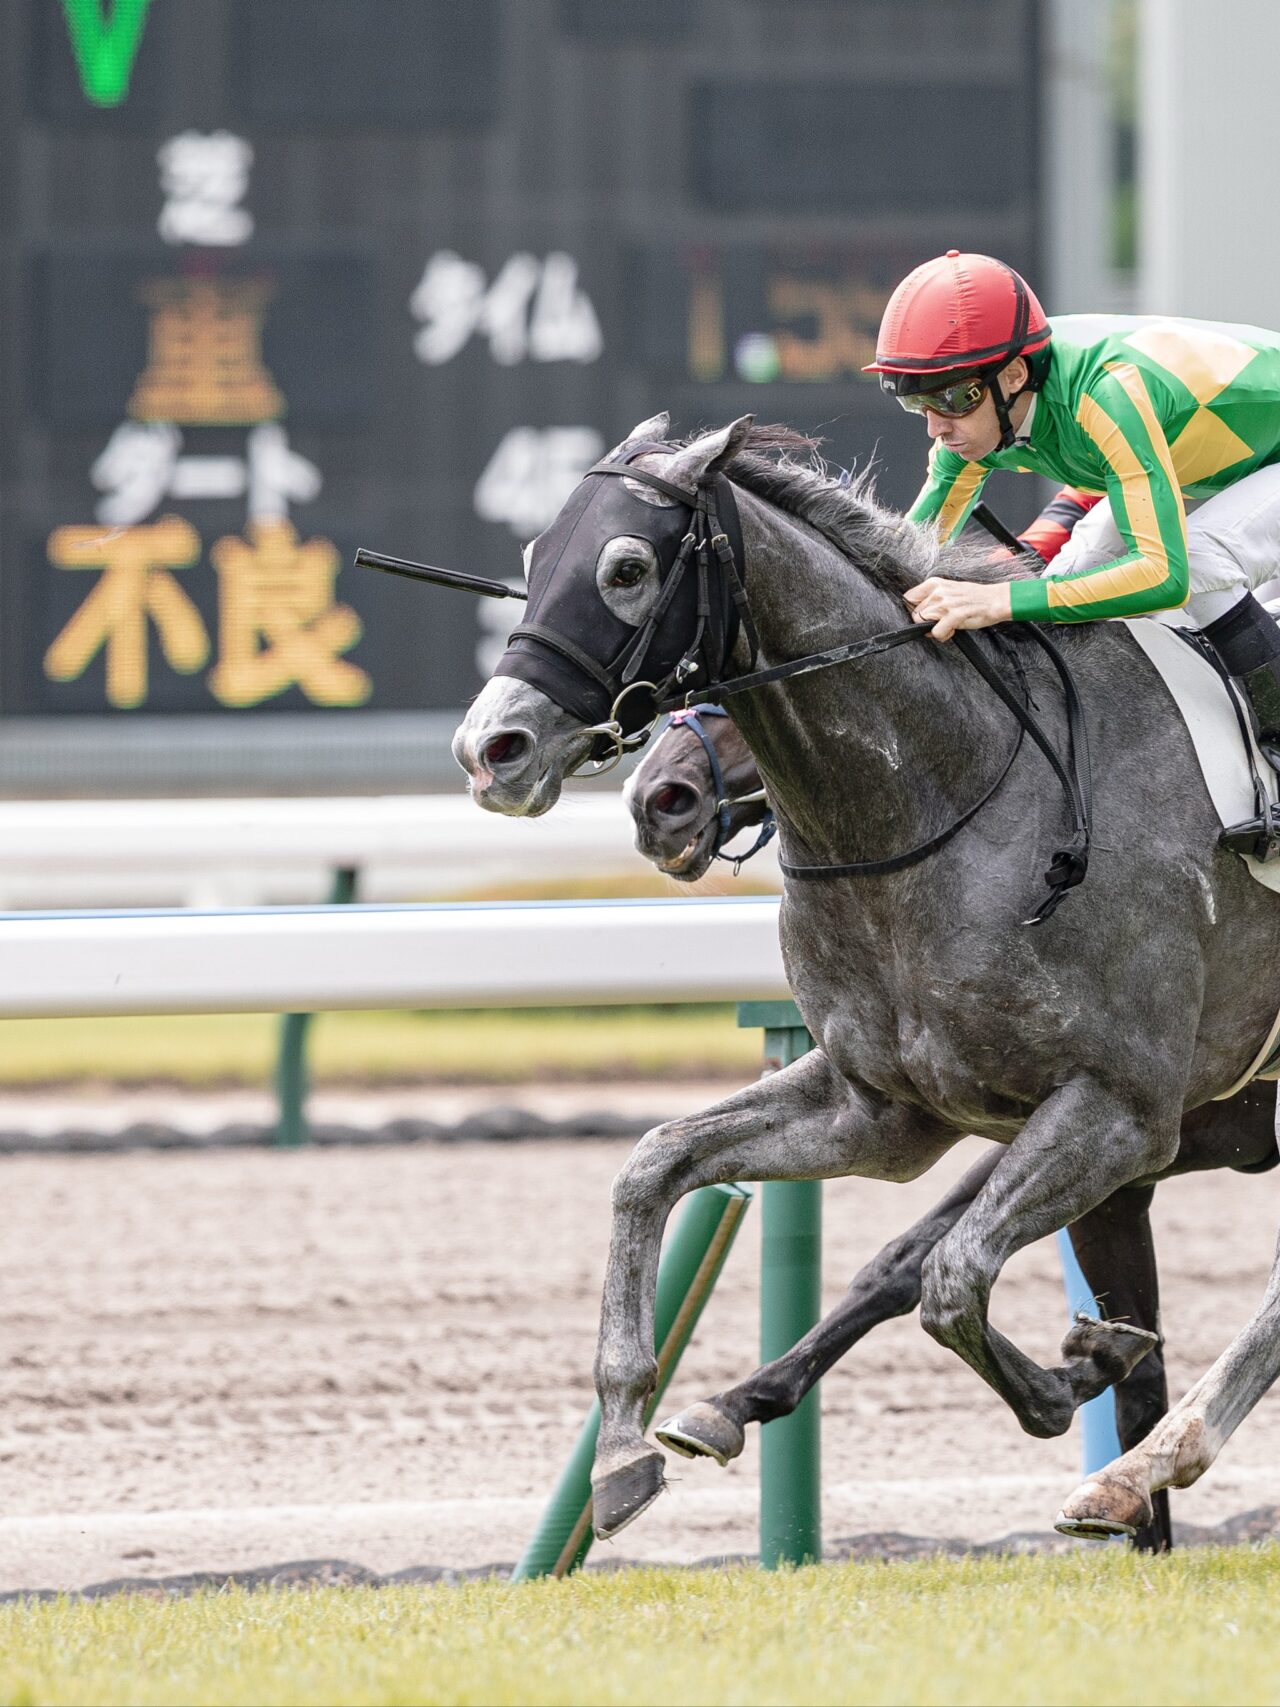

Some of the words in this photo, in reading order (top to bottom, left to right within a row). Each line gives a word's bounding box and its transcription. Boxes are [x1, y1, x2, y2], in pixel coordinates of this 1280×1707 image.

[411, 251, 602, 365] タイム
[44, 515, 372, 708] 不良
